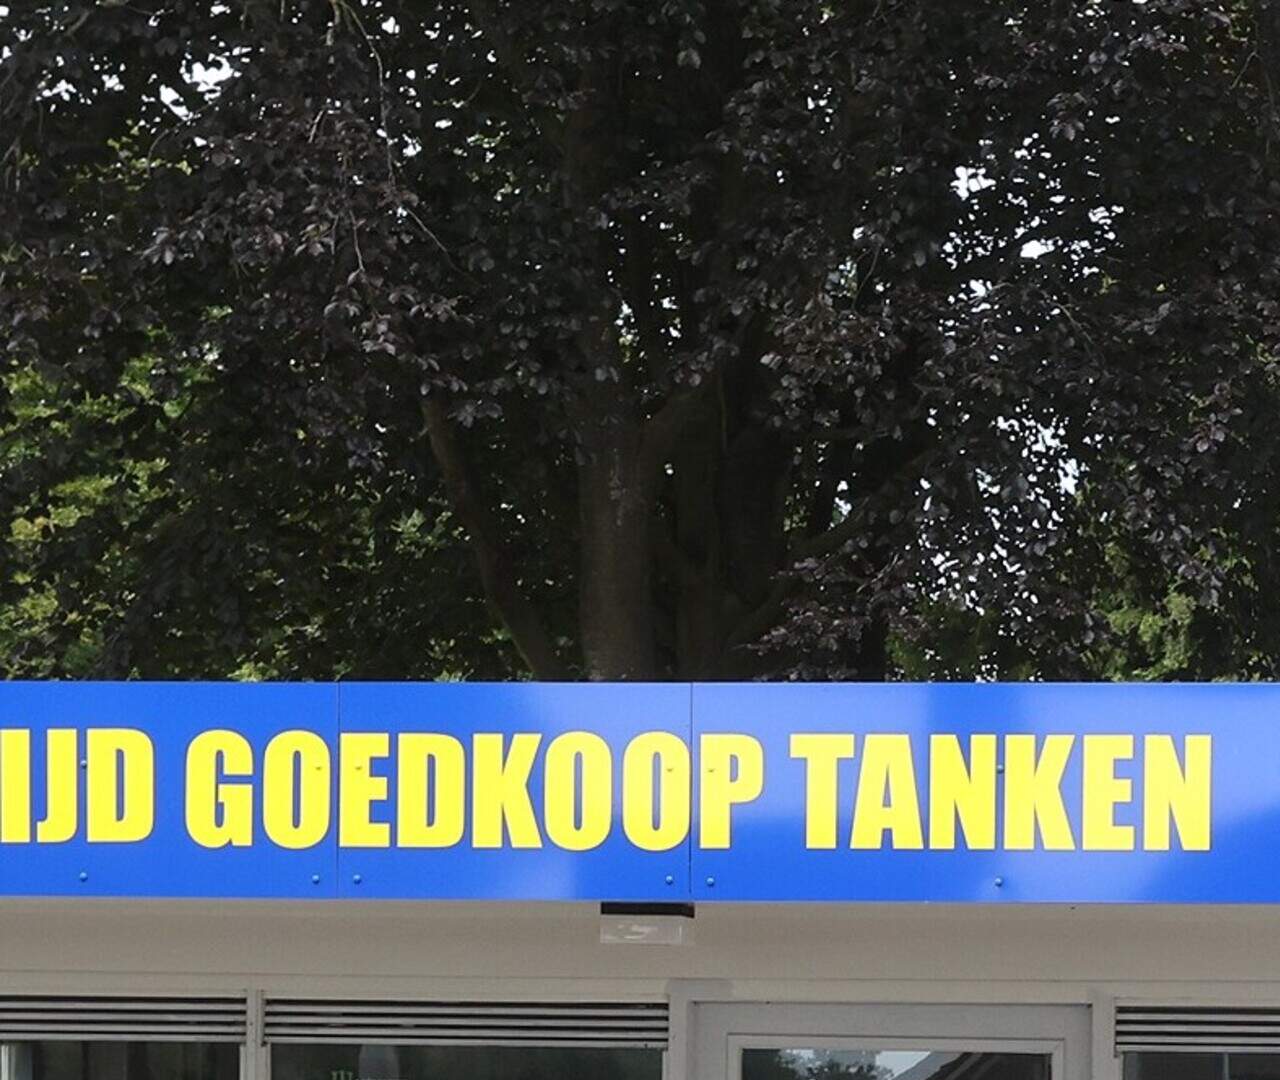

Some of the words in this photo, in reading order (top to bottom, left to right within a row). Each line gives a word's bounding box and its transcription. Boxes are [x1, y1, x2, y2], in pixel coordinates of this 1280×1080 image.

[0, 728, 155, 843] IJD
[185, 729, 764, 851] GOEDKOOP
[789, 733, 1212, 852] TANKEN
